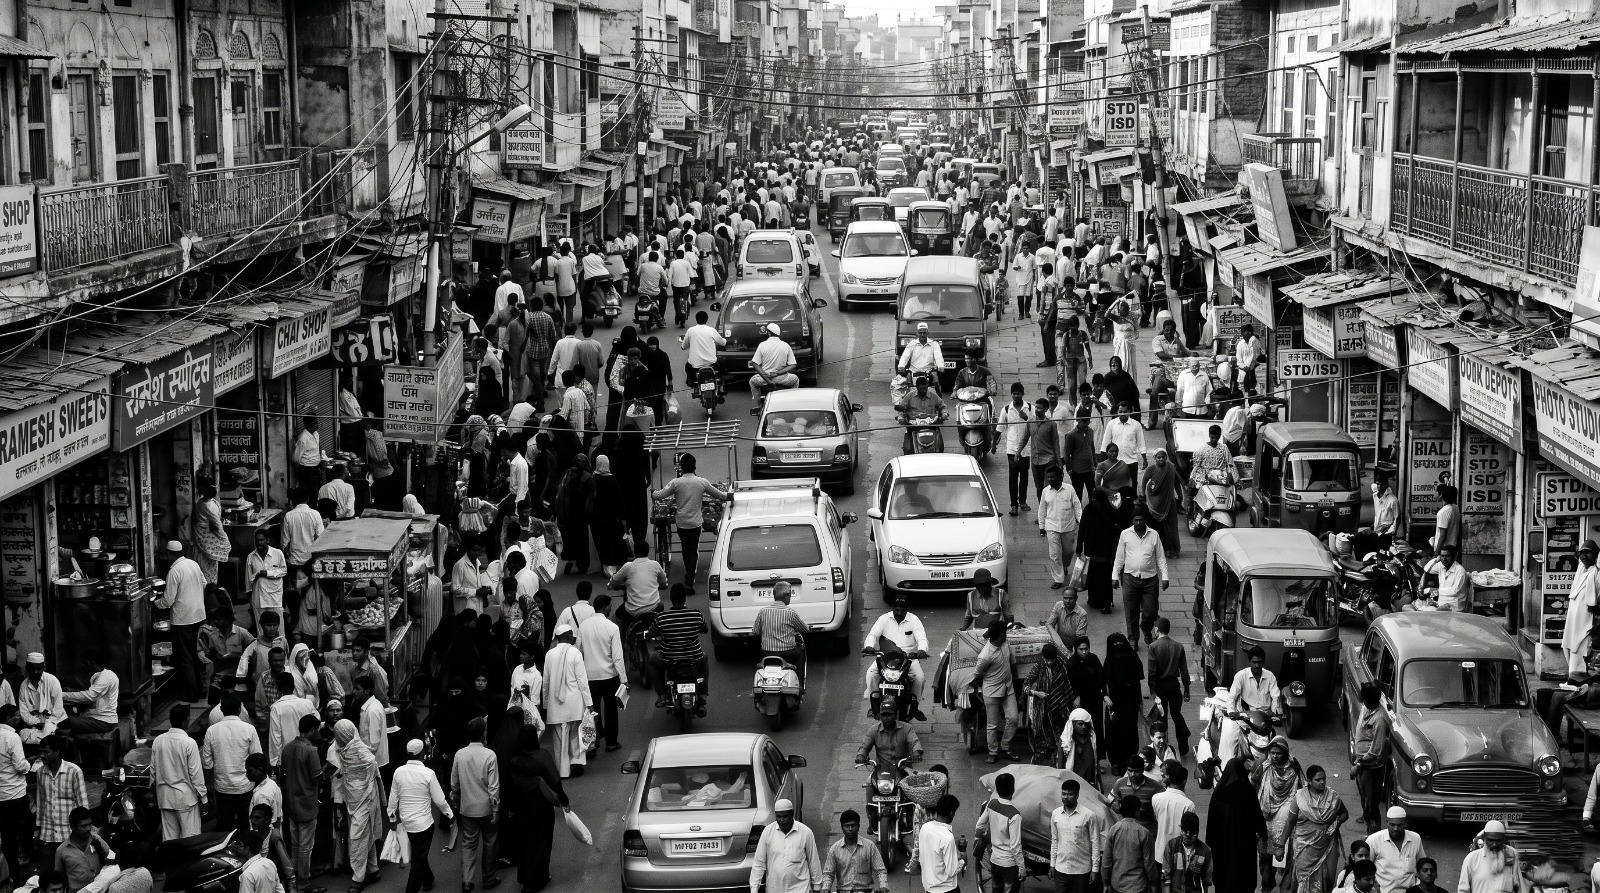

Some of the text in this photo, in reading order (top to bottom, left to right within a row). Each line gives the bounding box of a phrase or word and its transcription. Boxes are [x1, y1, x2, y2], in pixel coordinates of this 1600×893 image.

[1106, 103, 1136, 115] STD
[3, 200, 30, 228] SHOP
[278, 320, 300, 350] CHAI
[302, 310, 327, 341] SHOP
[1283, 363, 1339, 377] STD/ISD
[1535, 381, 1566, 426] PHOTO
[1568, 398, 1600, 444] STUDI
[0, 409, 55, 466] RAMESH
[59, 388, 107, 438] SWEETS
[1469, 459, 1500, 470] STD
[1468, 474, 1497, 486] ISD
[1466, 490, 1502, 503] ISD
